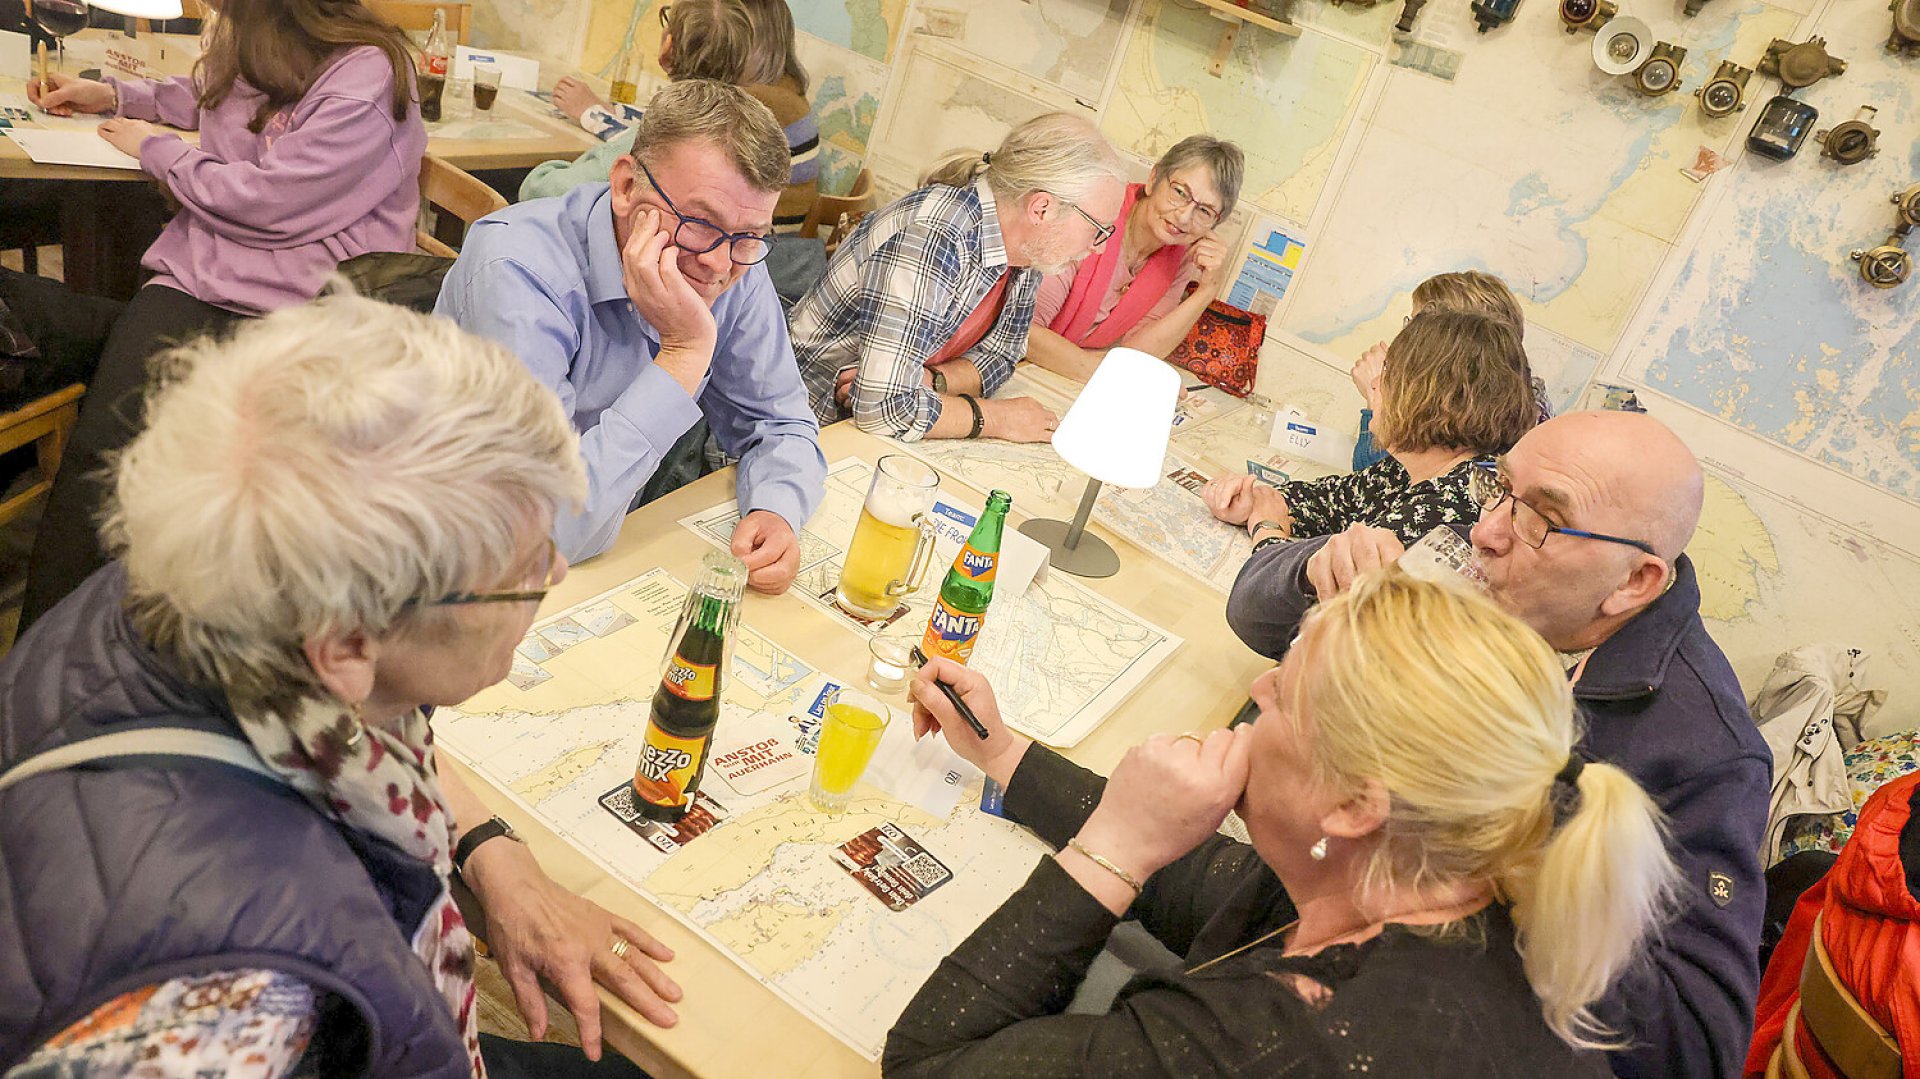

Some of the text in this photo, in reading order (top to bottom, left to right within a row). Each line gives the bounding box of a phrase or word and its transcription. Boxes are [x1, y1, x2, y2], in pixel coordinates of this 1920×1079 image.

[1288, 434, 1311, 448] ELLY
[963, 550, 994, 568] FANTA
[932, 601, 980, 636] FANTA
[666, 671, 687, 687] mix
[714, 737, 779, 767] ANSTOß
[742, 748, 774, 766] MIT
[728, 752, 793, 780] AUERHAHN
